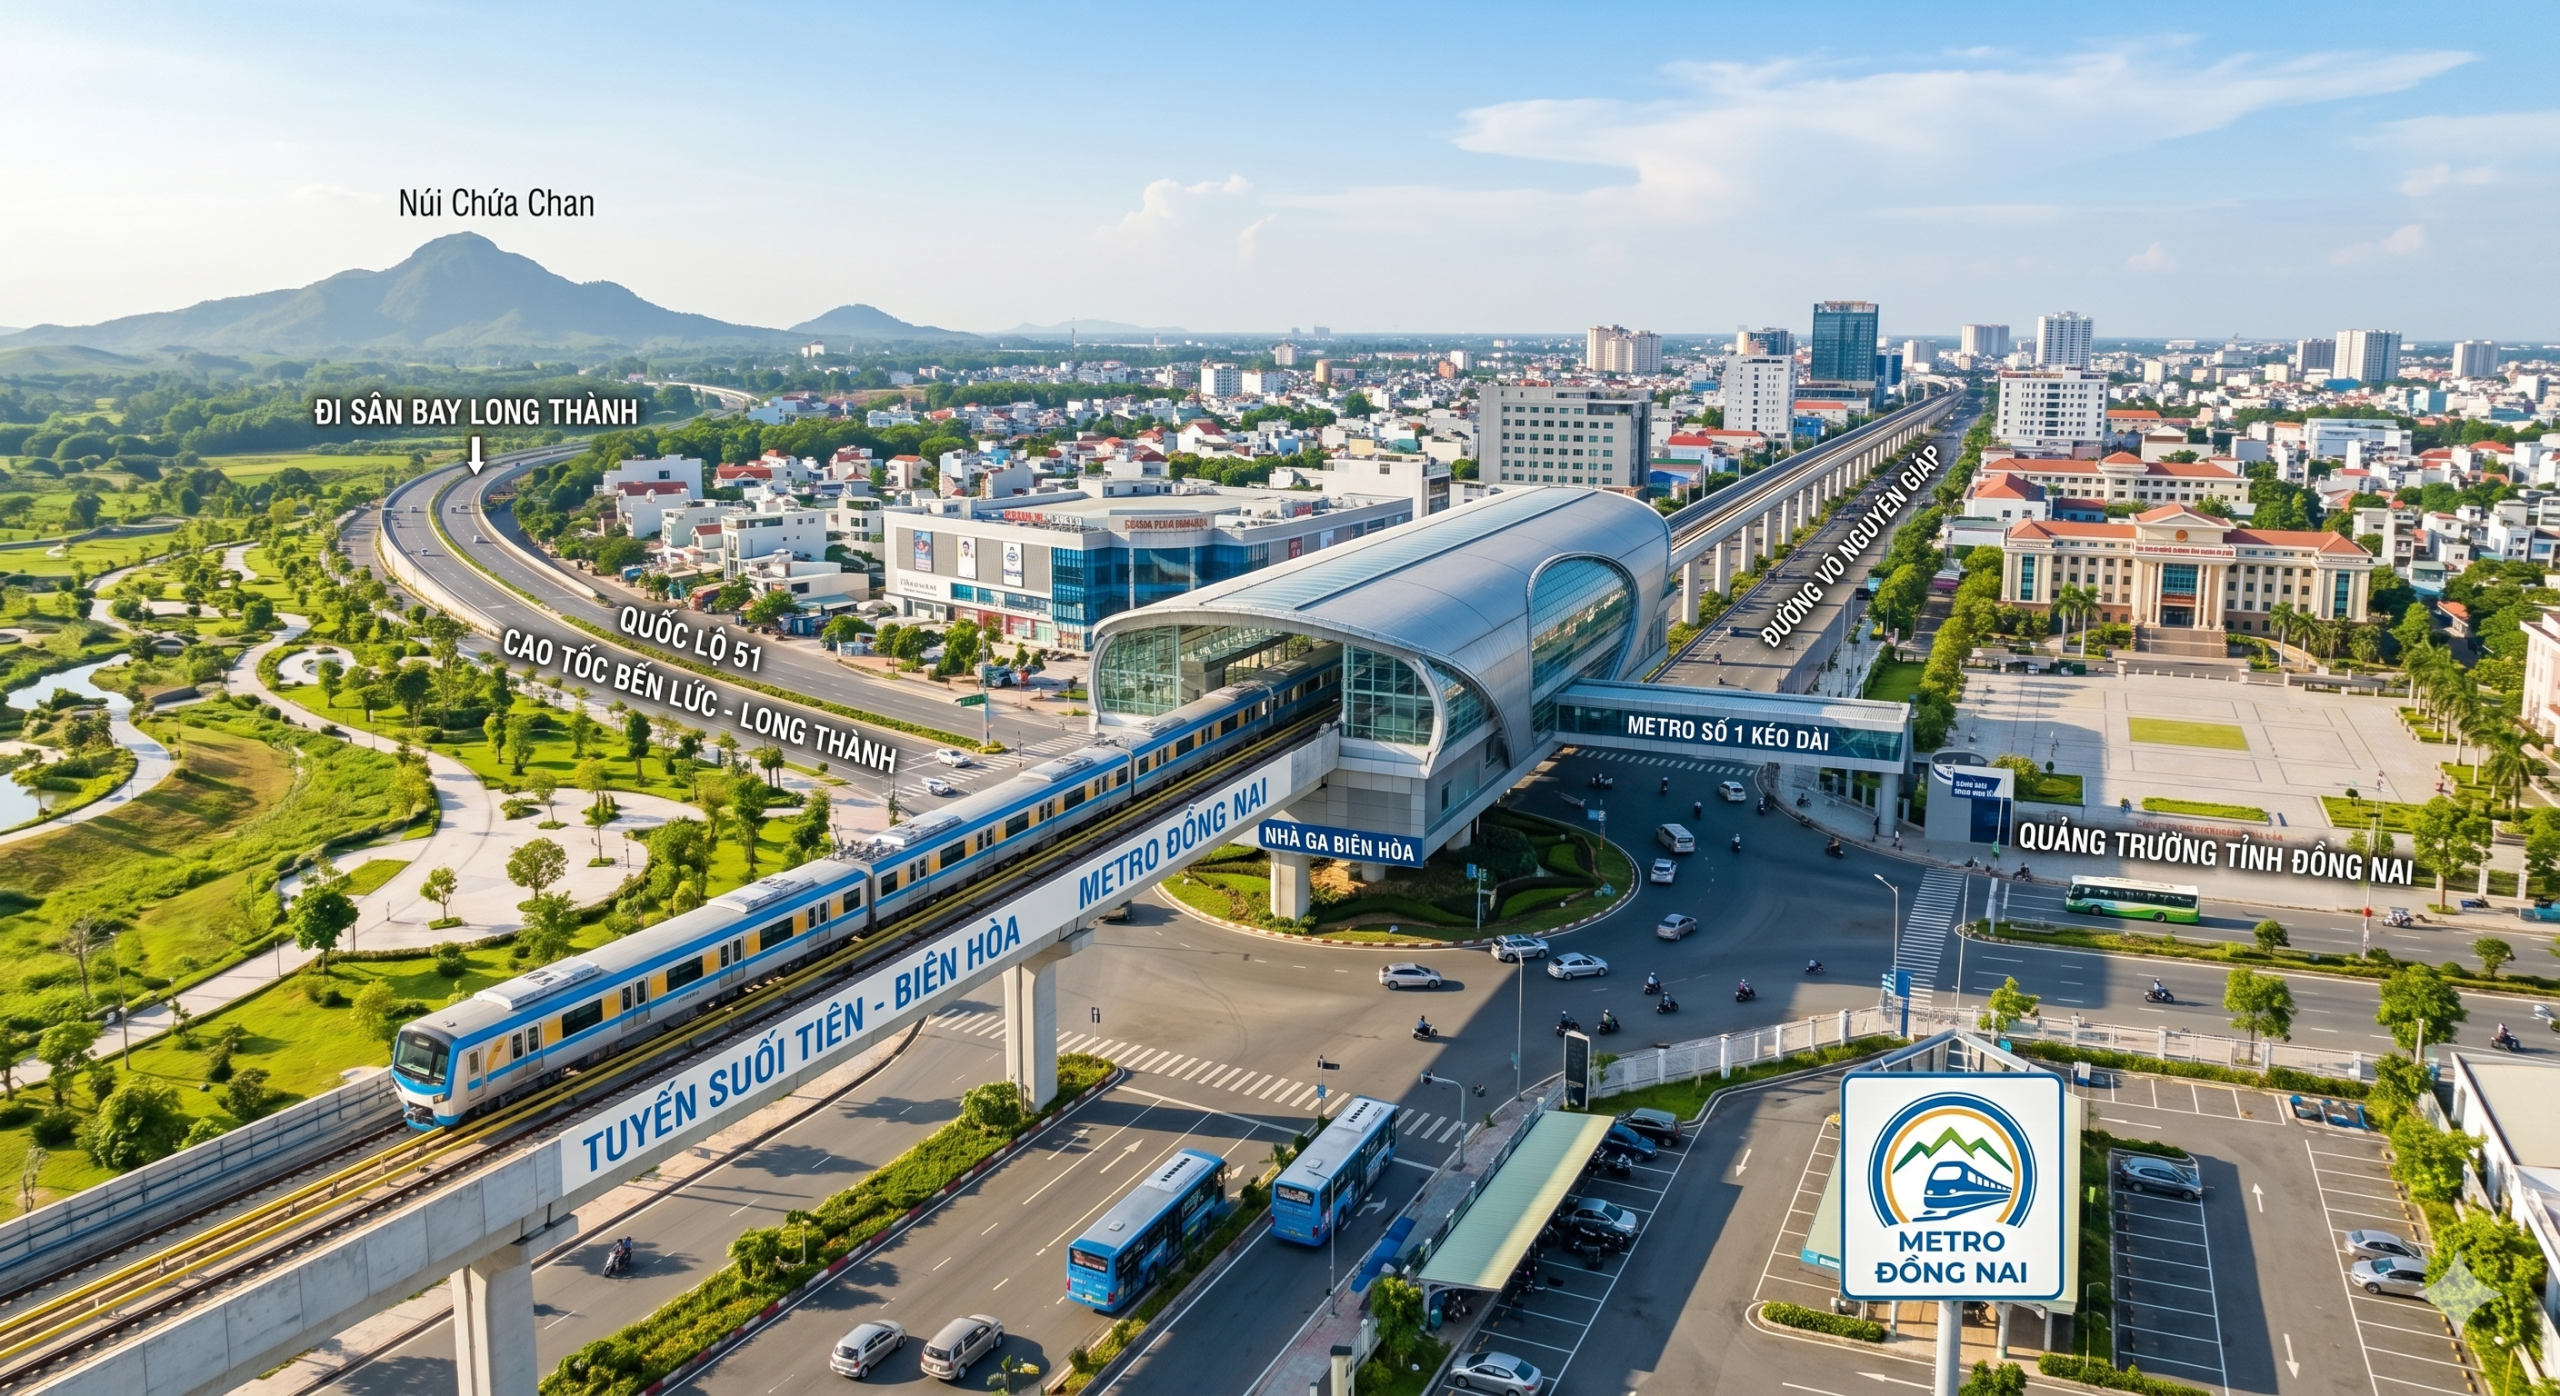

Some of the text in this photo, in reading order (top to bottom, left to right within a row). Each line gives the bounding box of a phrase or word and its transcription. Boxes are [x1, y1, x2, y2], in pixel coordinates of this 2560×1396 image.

[1628, 715, 1829, 751] METRO SỐ 1 KÉO DÀI
[1079, 777, 1267, 909] METRO ĐỒNG NAI
[1265, 825, 1415, 861] NHÀ GA BIÊN HÒA
[583, 1081, 698, 1172] TUYẾN
[709, 1030, 785, 1108] SUỐI
[795, 997, 864, 1061] TIÊN
[895, 947, 958, 1010] BIÊN
[967, 915, 1021, 970] HÒA
[1899, 1231, 2005, 1252] METRO
[1874, 1253, 2027, 1284] ĐỒNG NAI
